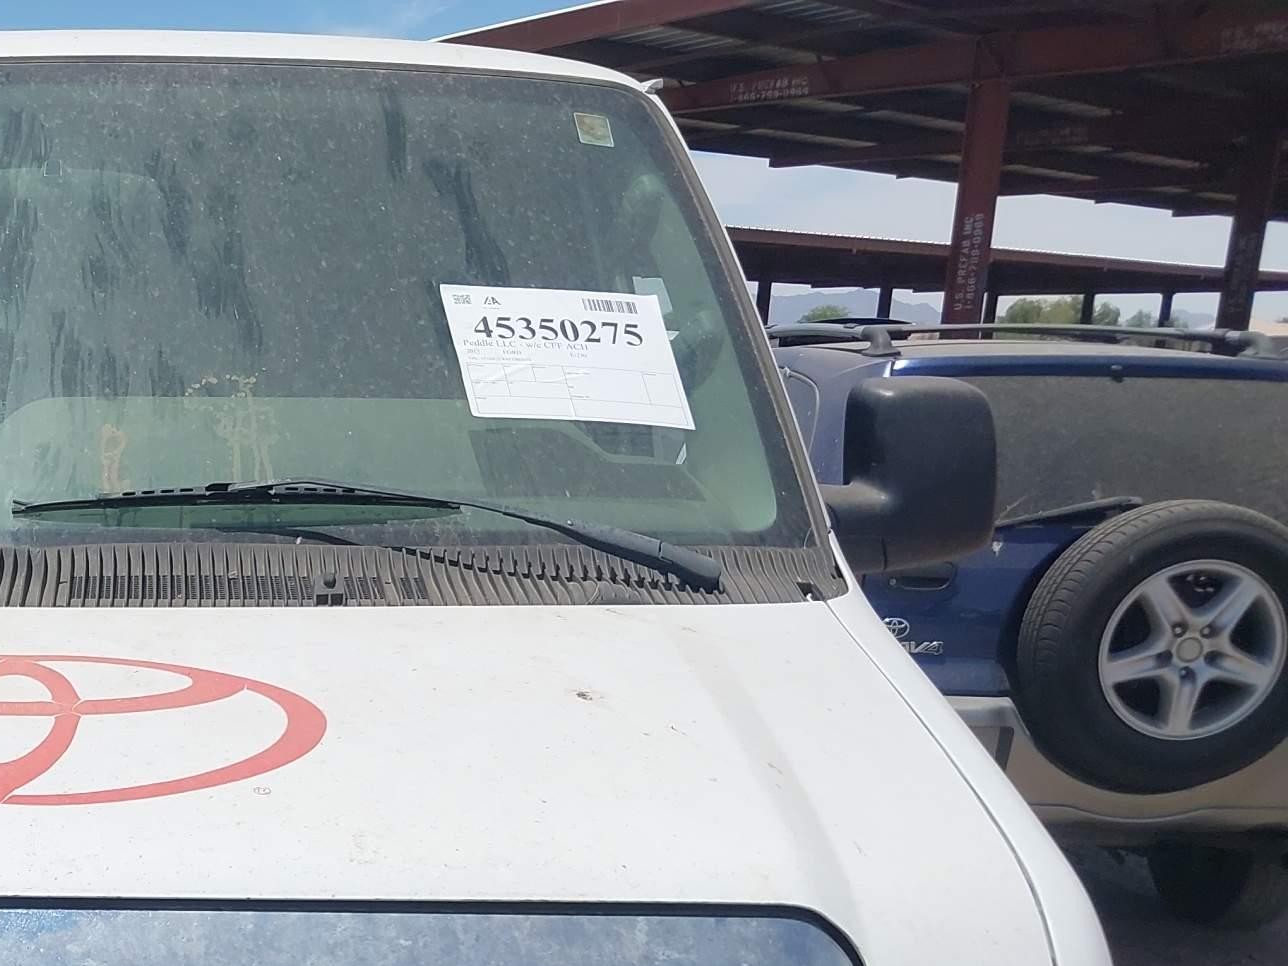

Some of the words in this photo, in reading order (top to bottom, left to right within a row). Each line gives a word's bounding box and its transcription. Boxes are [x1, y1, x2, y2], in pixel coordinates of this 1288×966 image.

[963, 216, 974, 236] INC
[957, 239, 972, 284] PREFAB
[474, 315, 644, 347] 45350275
